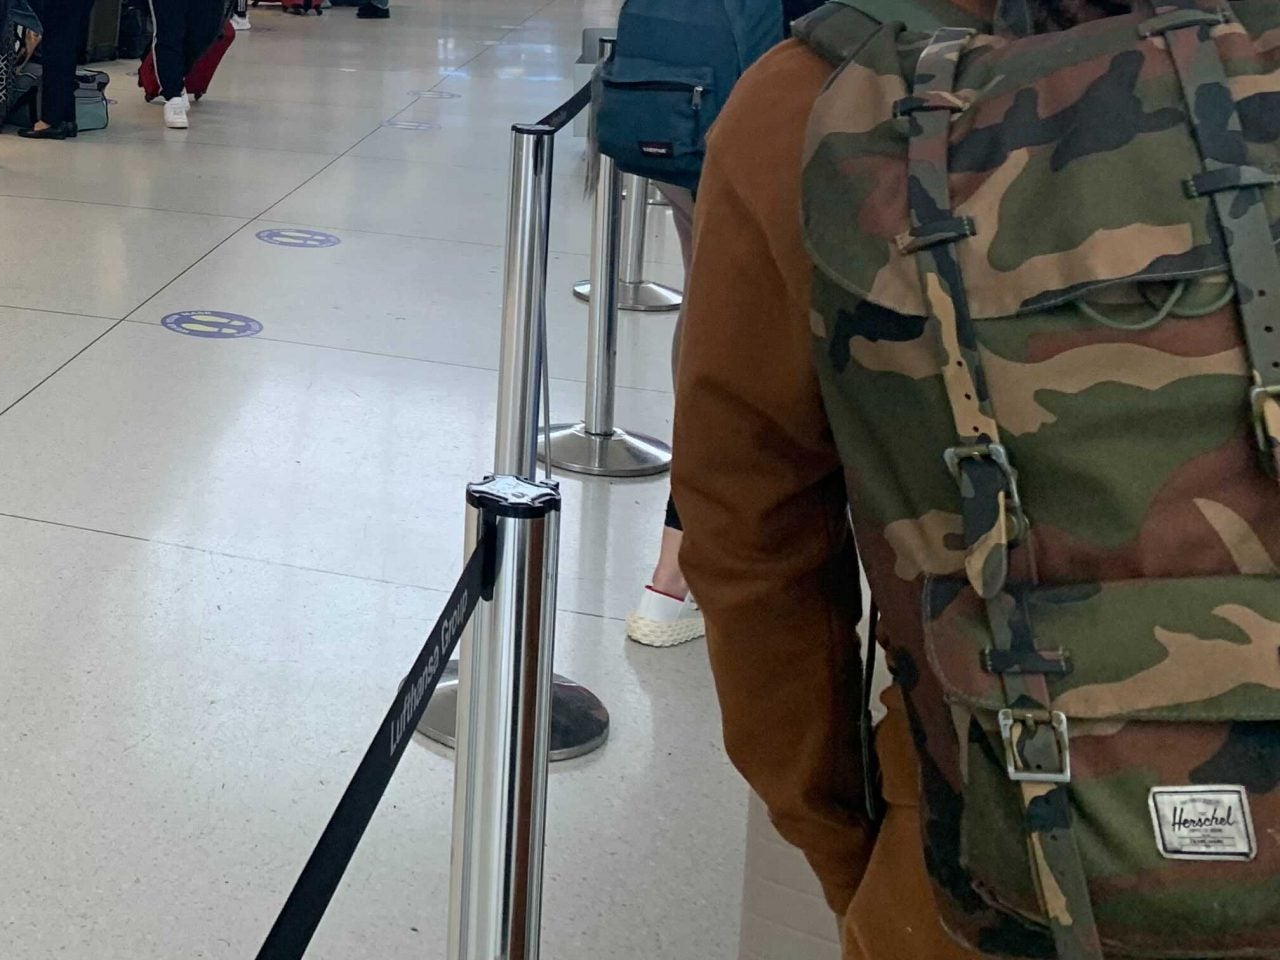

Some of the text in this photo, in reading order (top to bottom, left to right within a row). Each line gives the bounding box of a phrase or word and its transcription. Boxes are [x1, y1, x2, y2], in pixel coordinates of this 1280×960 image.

[390, 589, 469, 757] Lufthansa Group
[1172, 805, 1236, 832] Herschel
